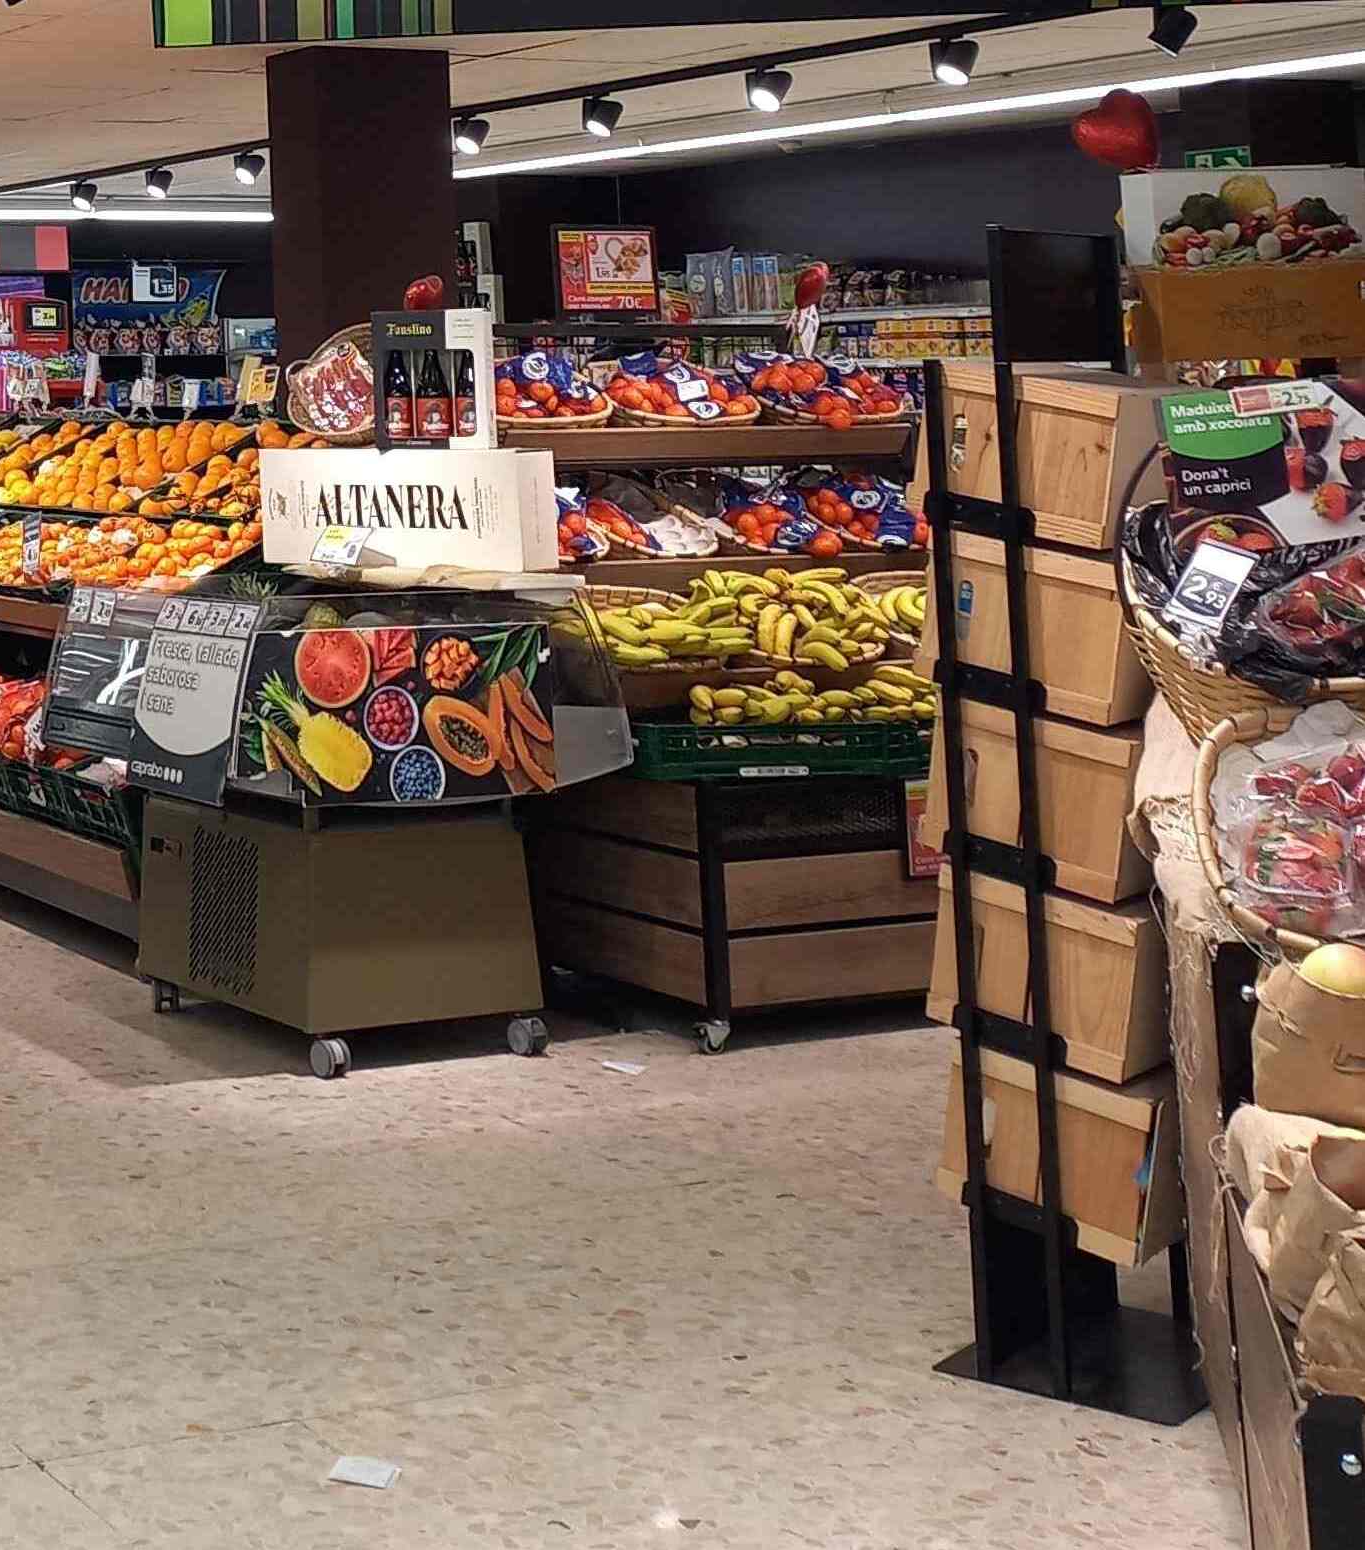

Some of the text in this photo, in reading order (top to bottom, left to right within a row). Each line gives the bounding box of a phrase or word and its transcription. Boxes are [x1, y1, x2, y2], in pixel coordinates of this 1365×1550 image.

[386, 322, 432, 336] Faustino
[1169, 399, 1235, 418] Maduixe
[1173, 419, 1206, 434] amb
[1181, 467, 1229, 482] Dona't
[1184, 478, 1253, 497] un caprici
[315, 483, 470, 531] ALTANERA
[145, 663, 200, 691] saborosa
[146, 693, 175, 715] sana
